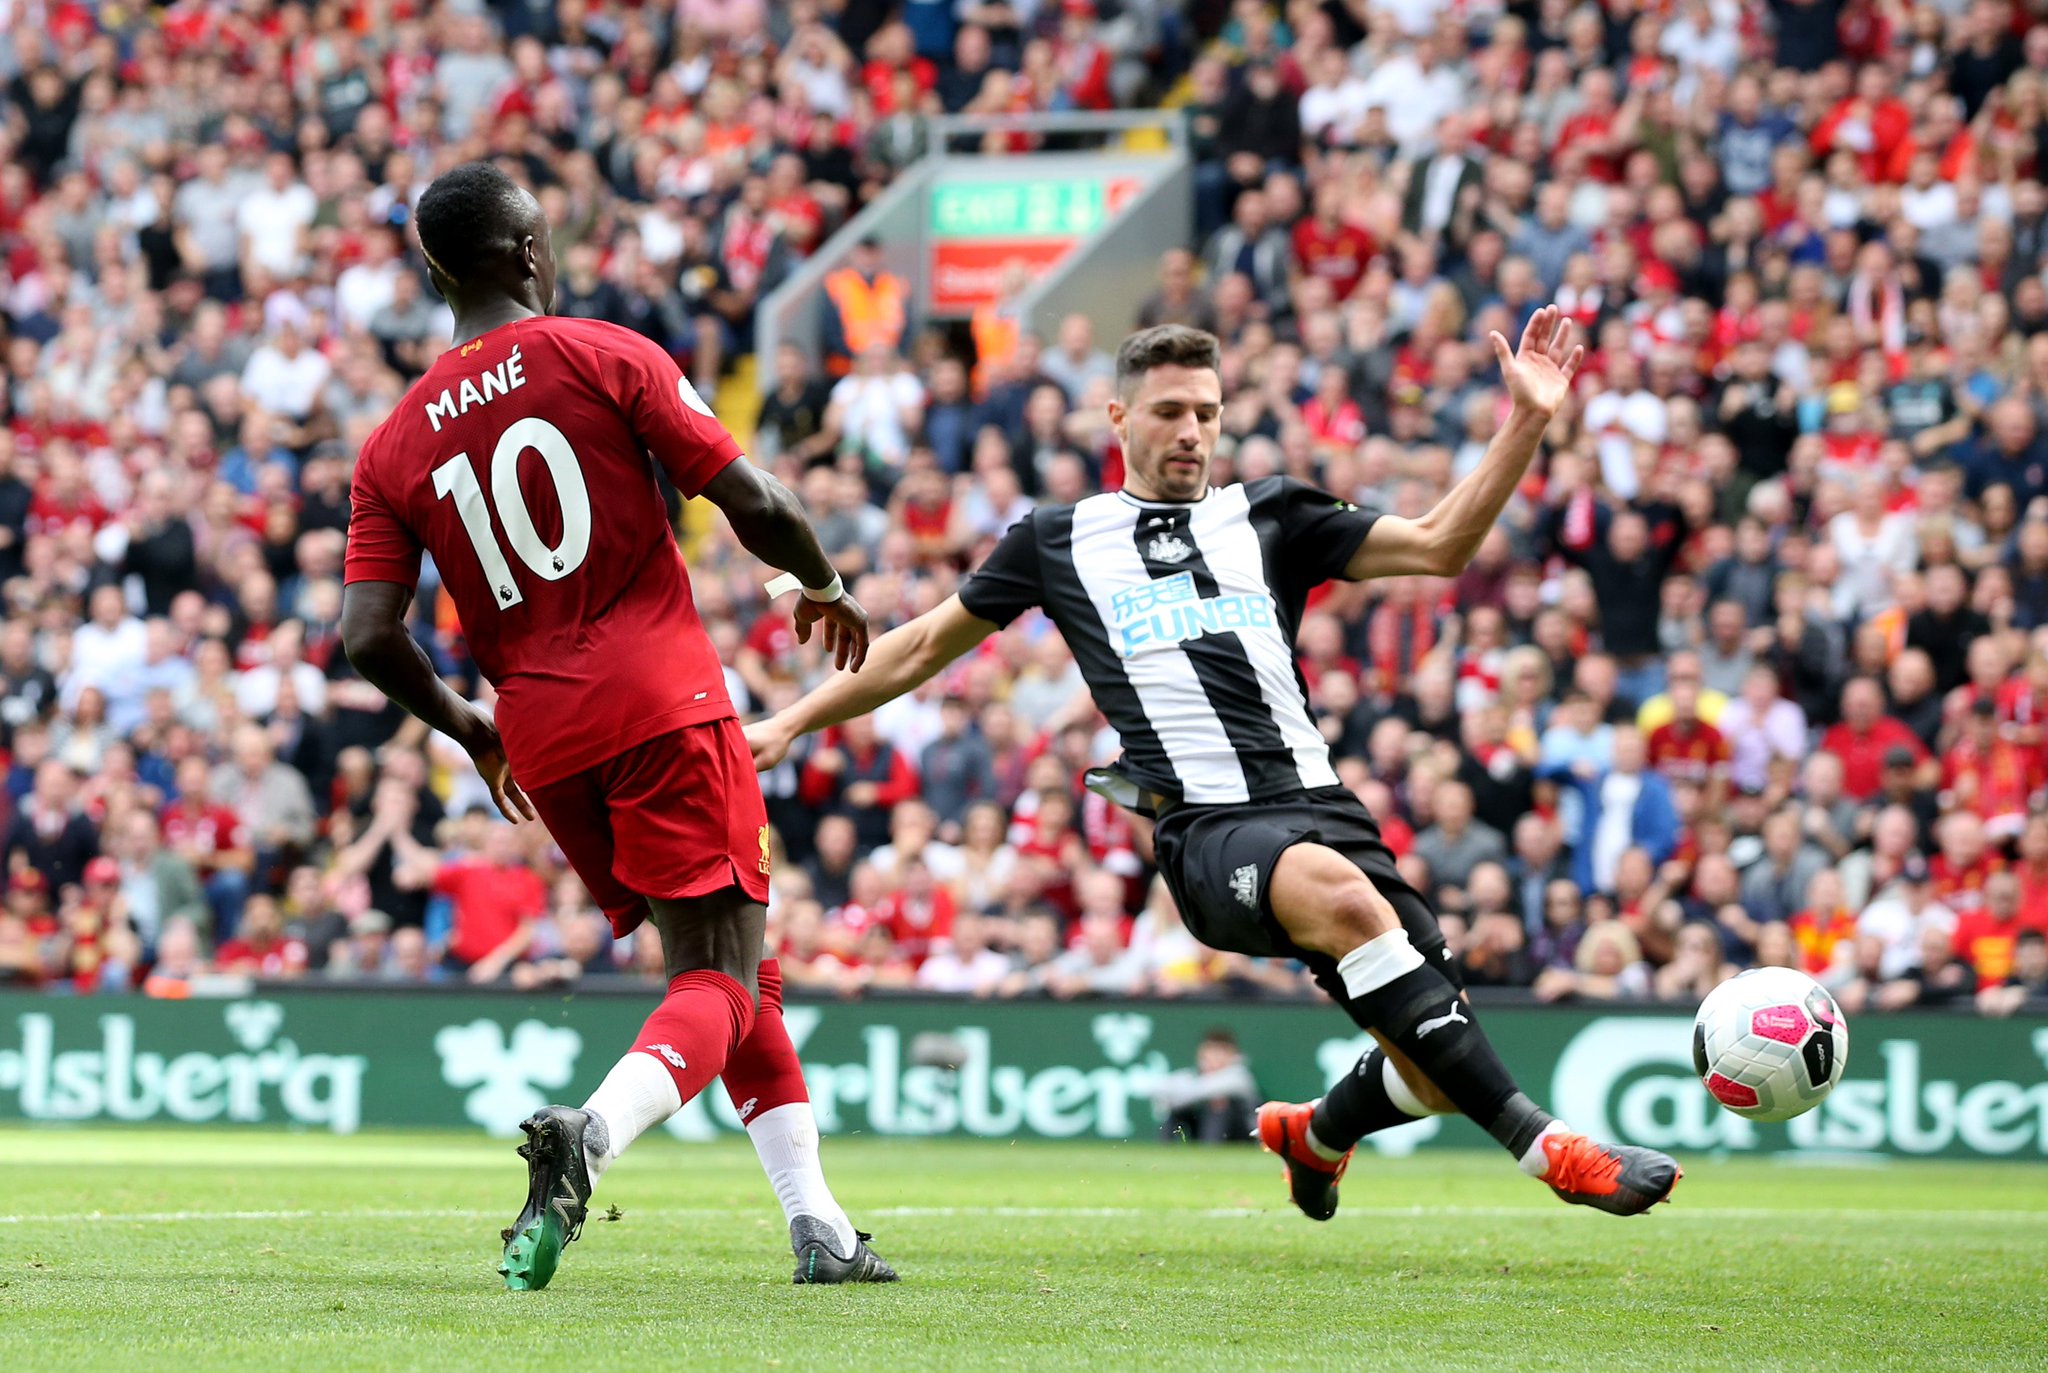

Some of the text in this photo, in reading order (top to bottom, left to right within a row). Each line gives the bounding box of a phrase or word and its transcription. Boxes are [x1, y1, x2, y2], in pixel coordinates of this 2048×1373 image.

[424, 344, 526, 432] MANÉ
[431, 417, 592, 611] 10
[1112, 573, 1195, 623] 乐天堂
[1121, 594, 1272, 657] FUN88
